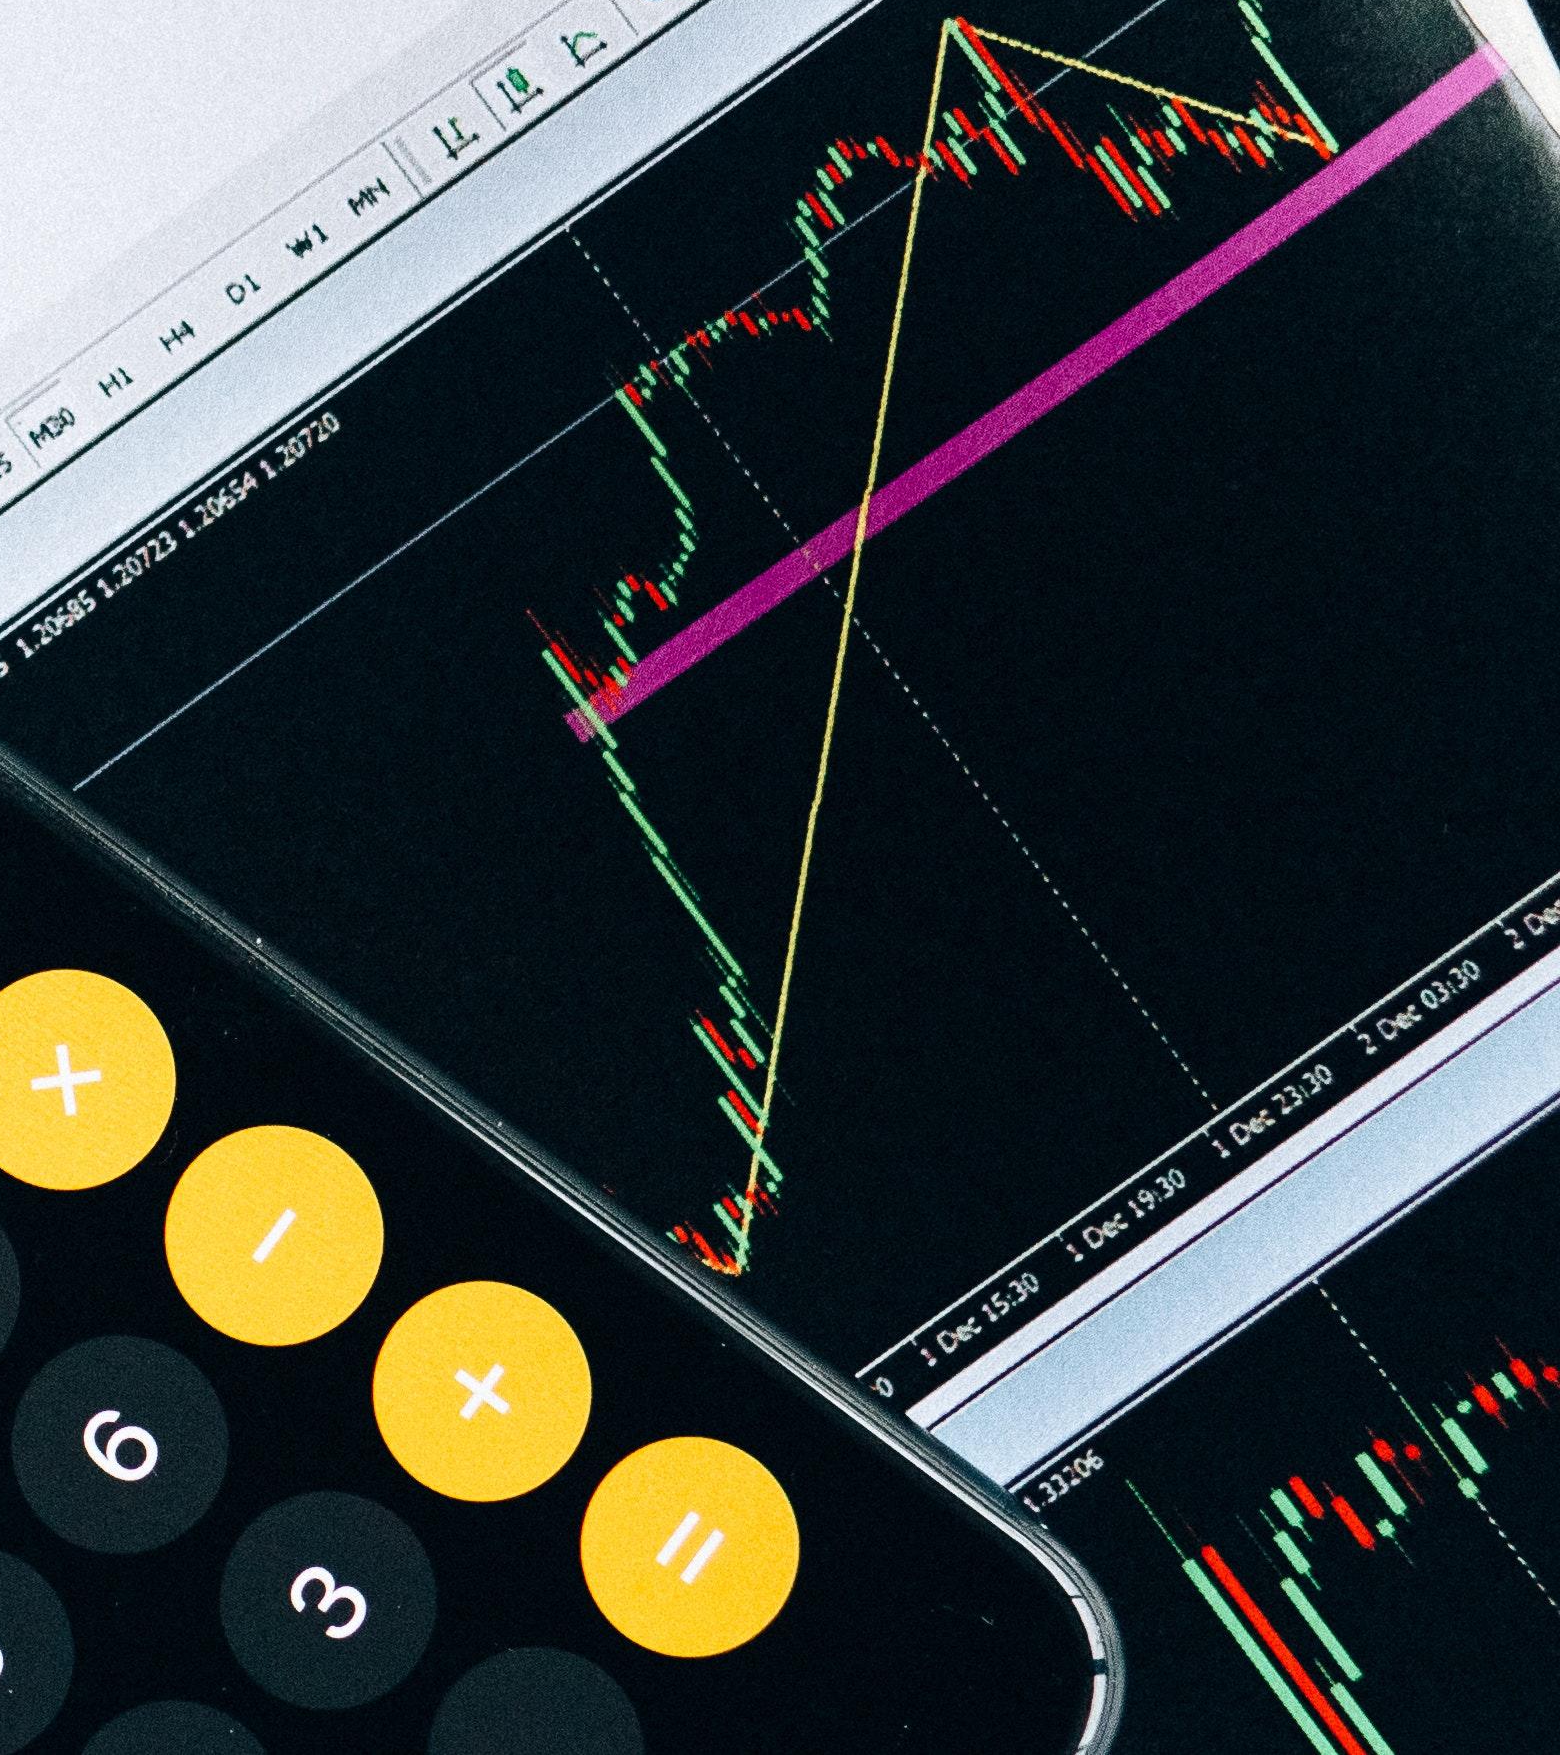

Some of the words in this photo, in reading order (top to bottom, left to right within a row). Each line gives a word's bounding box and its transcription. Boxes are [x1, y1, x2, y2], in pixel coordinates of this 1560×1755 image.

[97, 367, 134, 398] H1
[159, 319, 196, 355] H4
[285, 223, 330, 259] W1
[346, 177, 391, 217] MN
[95, 530, 178, 599] 1.20723
[258, 411, 341, 480] 1.20720
[1503, 928, 1526, 950] 2
[1356, 1033, 1378, 1056] 2
[1375, 1003, 1422, 1041] Dec
[1420, 959, 1482, 1011] 03:30
[1228, 1108, 1276, 1146] Dec
[1271, 1063, 1334, 1116] 23:30
[1082, 1212, 1129, 1250] Dec
[1127, 1167, 1186, 1219] 19:30
[936, 1316, 983, 1354] Dec
[981, 1272, 1040, 1323] 15:30
[83, 1409, 159, 1482] 6
[290, 1566, 367, 1639] 3
